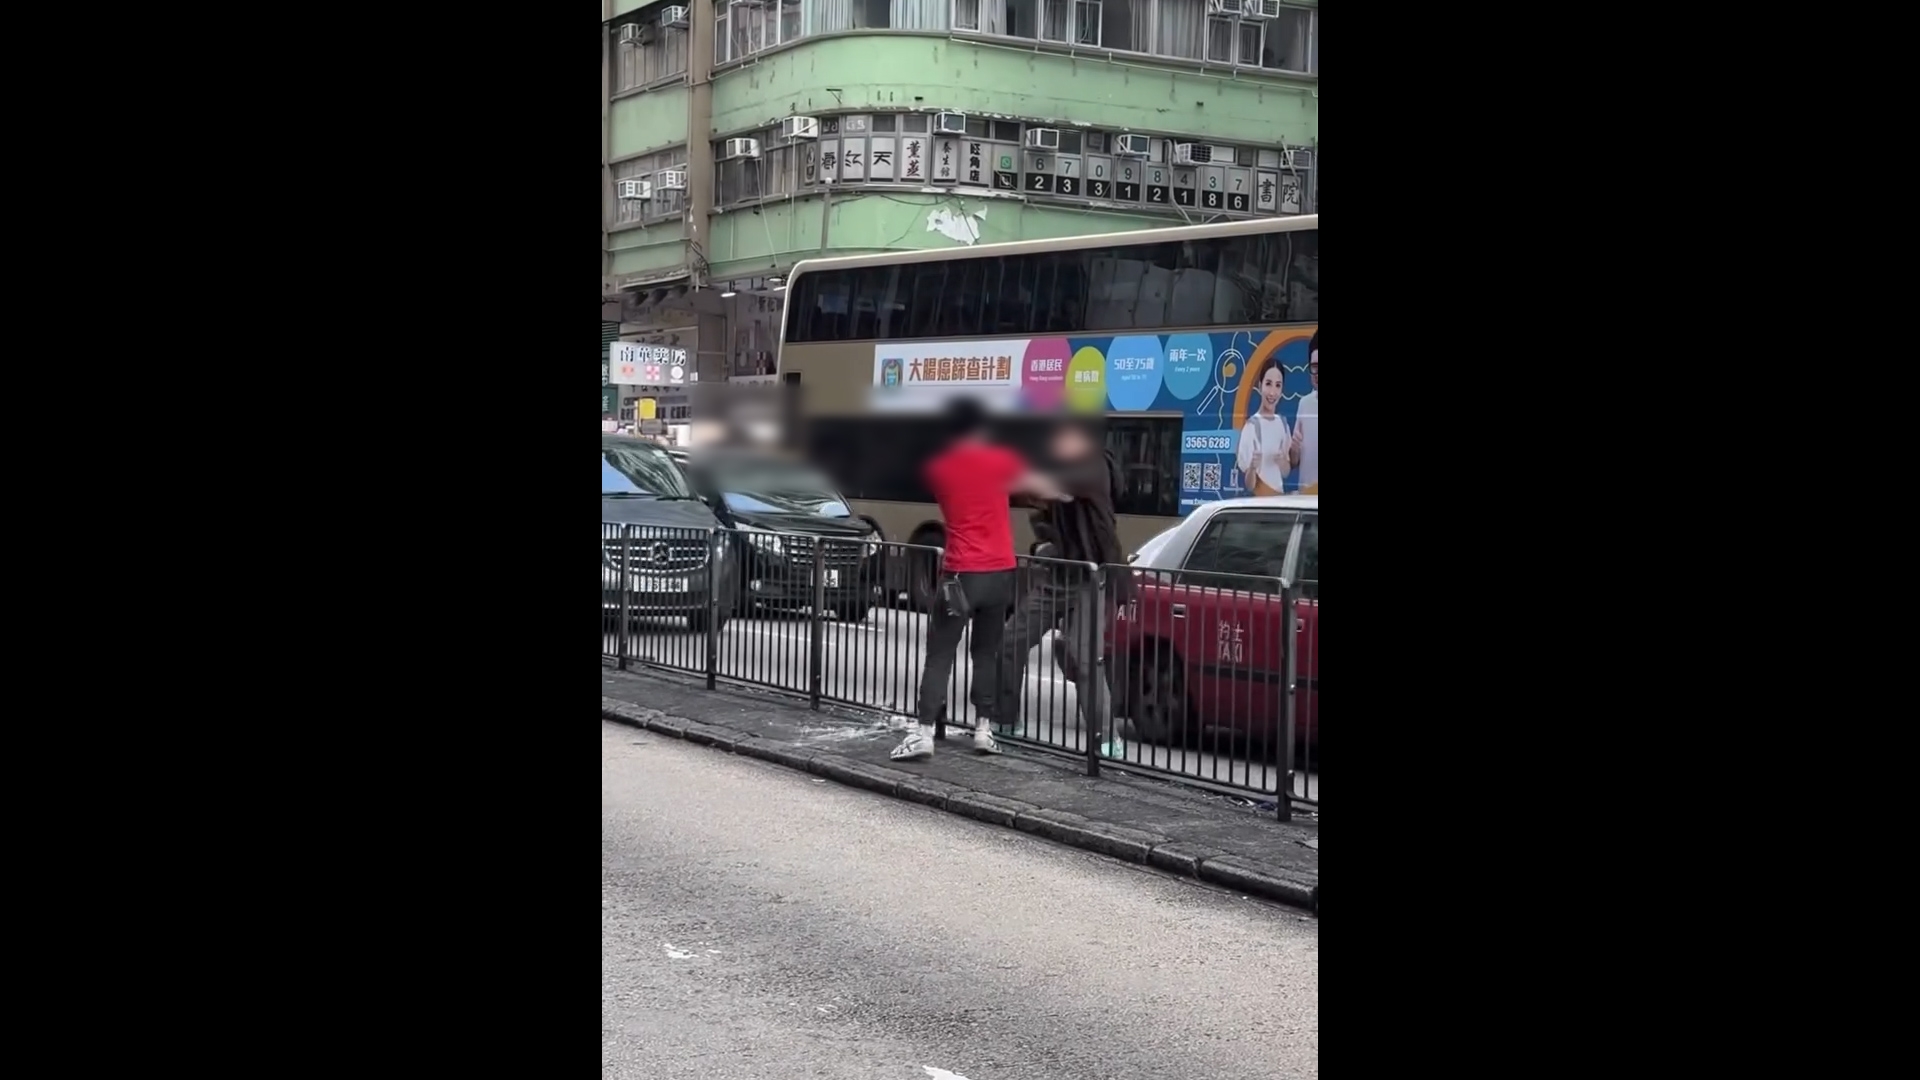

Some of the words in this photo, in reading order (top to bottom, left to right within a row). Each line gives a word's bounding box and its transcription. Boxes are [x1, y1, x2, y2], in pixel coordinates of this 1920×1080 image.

[969, 142, 981, 182] 旺角店
[1258, 178, 1299, 205] 書院
[909, 355, 1012, 381] 大腸癌篩查計劃
[1113, 357, 1155, 370] 50至75歲
[1185, 436, 1207, 449] 3565
[1208, 436, 1231, 449] 6288
